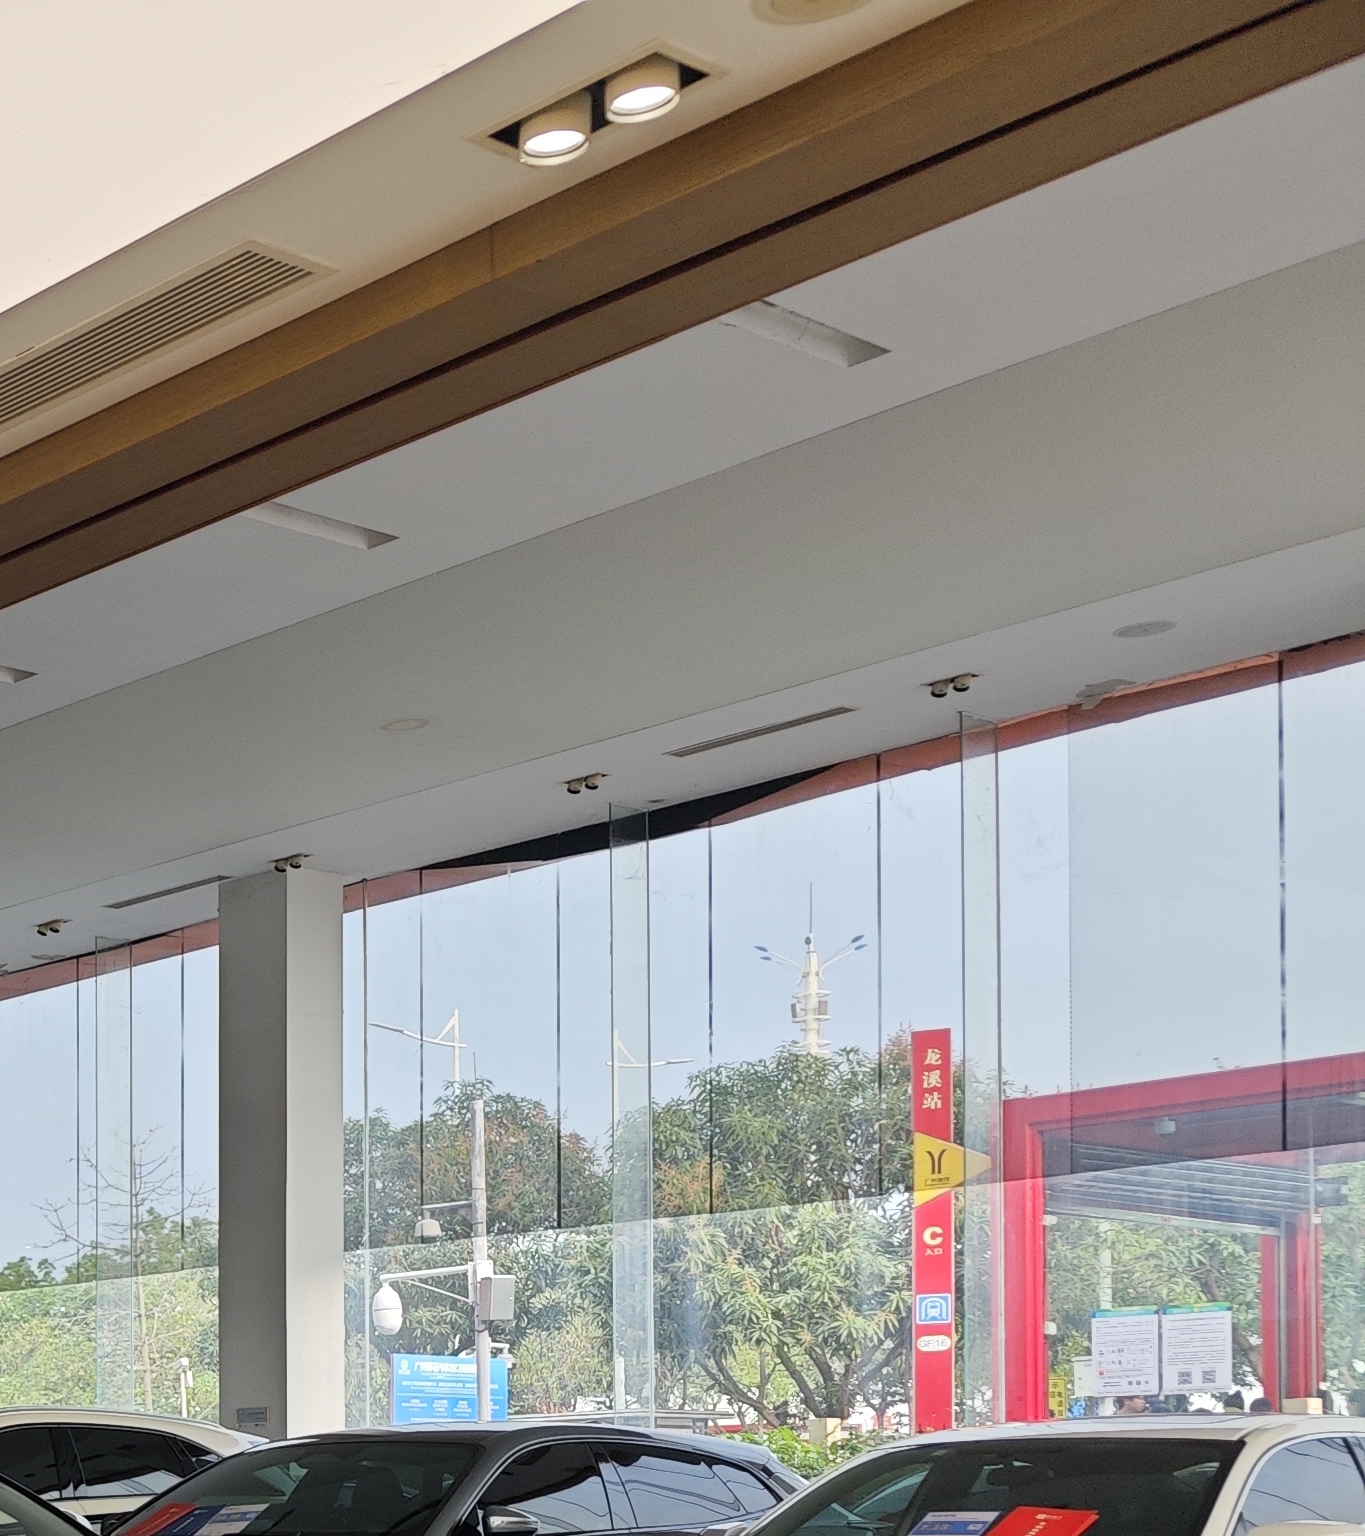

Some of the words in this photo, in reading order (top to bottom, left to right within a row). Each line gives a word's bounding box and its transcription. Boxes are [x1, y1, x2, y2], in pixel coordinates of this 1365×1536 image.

[922, 1048, 943, 1110] 龙溪站
[923, 1226, 944, 1245] C
[925, 1248, 943, 1256] 入口
